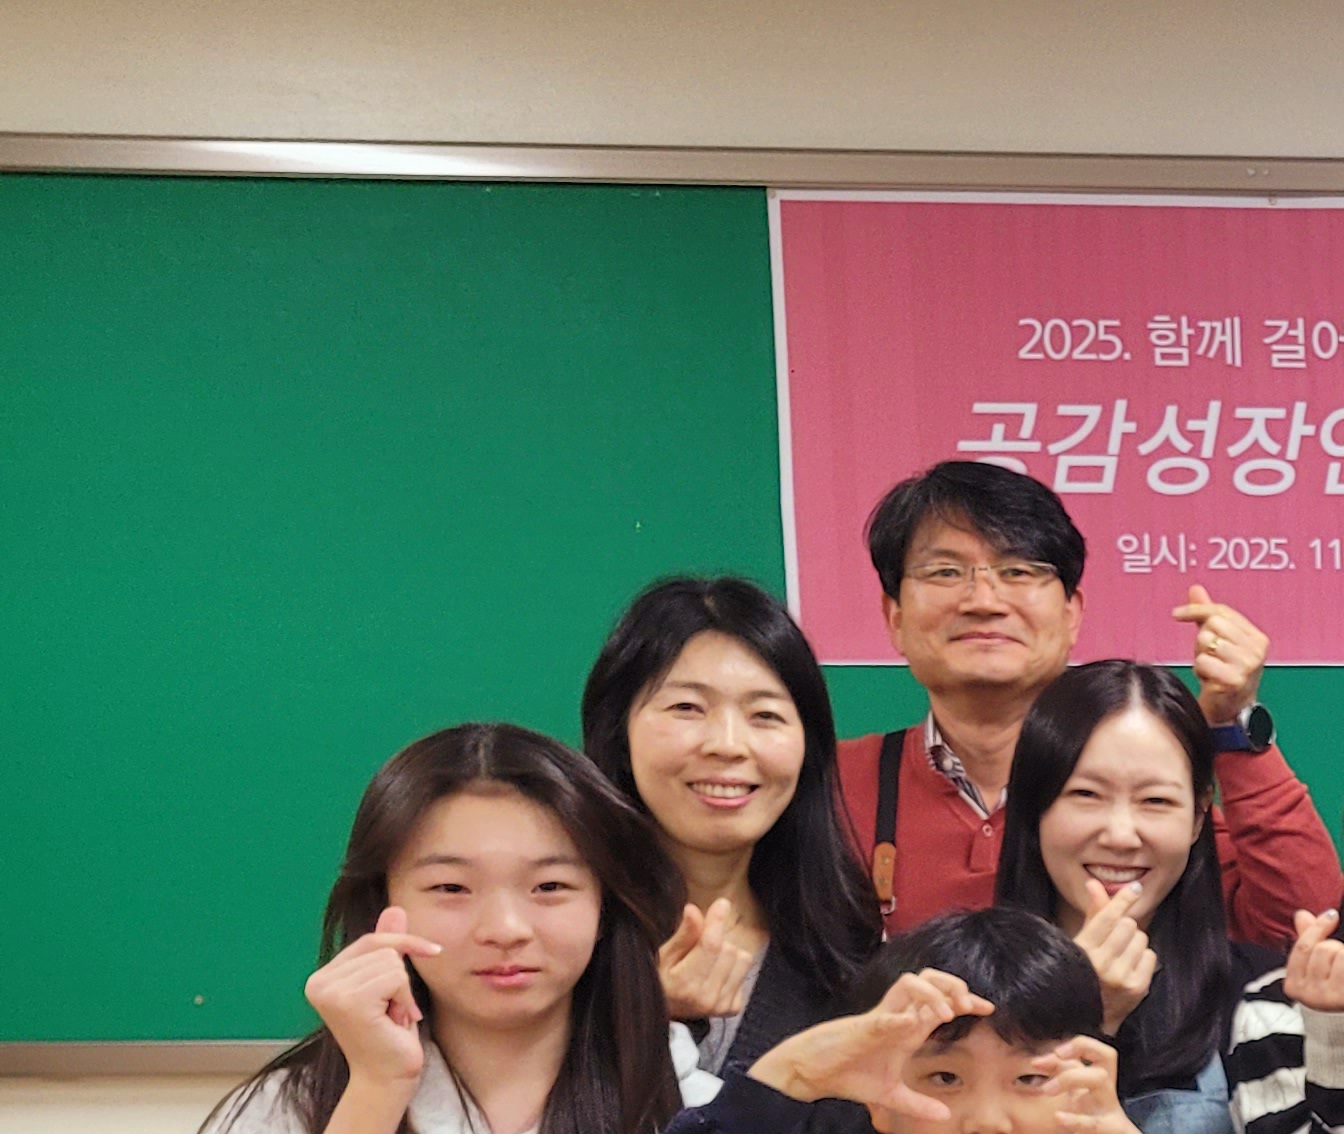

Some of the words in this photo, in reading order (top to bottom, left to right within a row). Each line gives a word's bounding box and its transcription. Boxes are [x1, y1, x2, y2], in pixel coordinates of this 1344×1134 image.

[1018, 318, 1131, 361] 2025.
[1147, 315, 1242, 367] 함께
[1116, 533, 1197, 573] 일시:
[1208, 537, 1295, 570] 2025.
